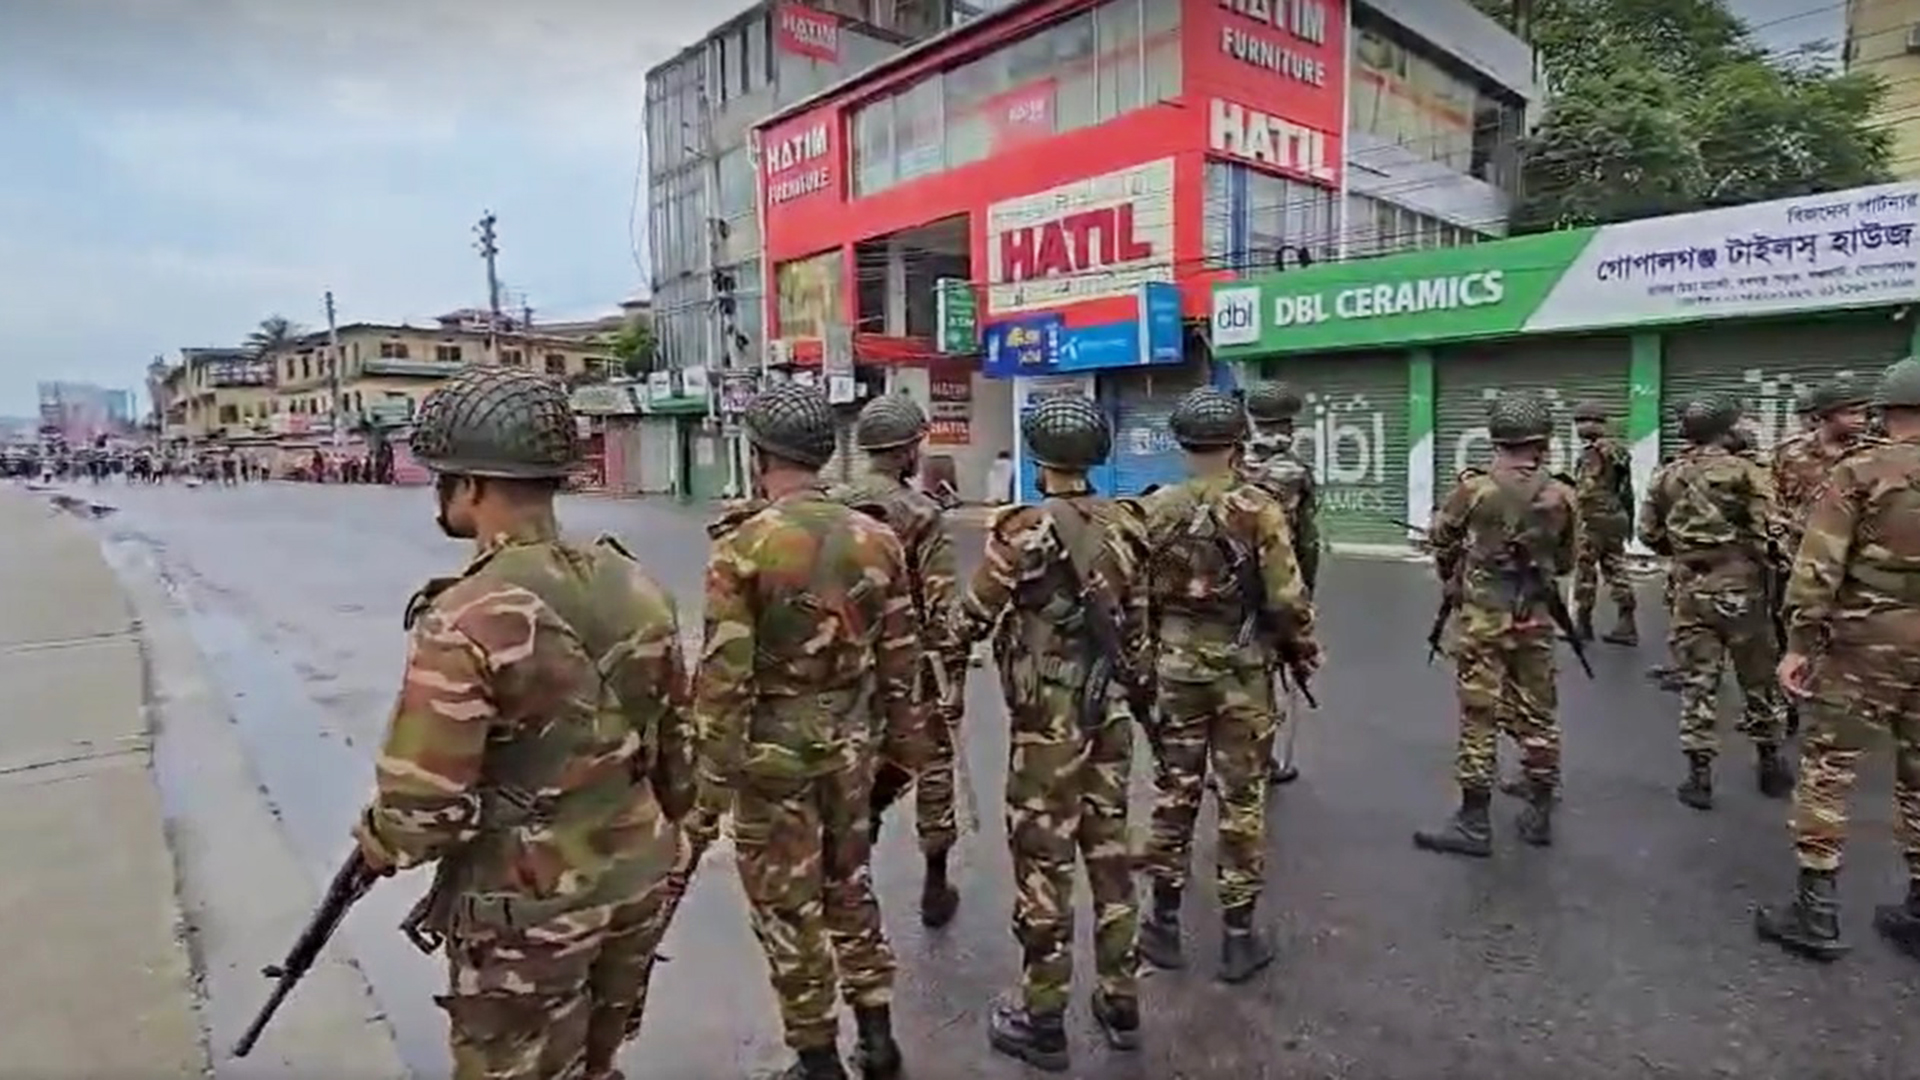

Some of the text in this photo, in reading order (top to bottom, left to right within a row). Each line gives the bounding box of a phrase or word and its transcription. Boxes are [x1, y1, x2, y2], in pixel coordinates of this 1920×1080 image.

[1219, 0, 1325, 44] ATIM
[1222, 26, 1325, 86] FURNITURE
[767, 122, 827, 175] HATIM
[1209, 98, 1336, 182] HATIL
[1001, 202, 1153, 283] HATIL
[1597, 247, 1717, 281] গোপালগঞ্জ
[1829, 221, 1916, 255] হাউজ
[1217, 302, 1254, 330] dbl
[1275, 271, 1504, 326] DBL CERAMICS
